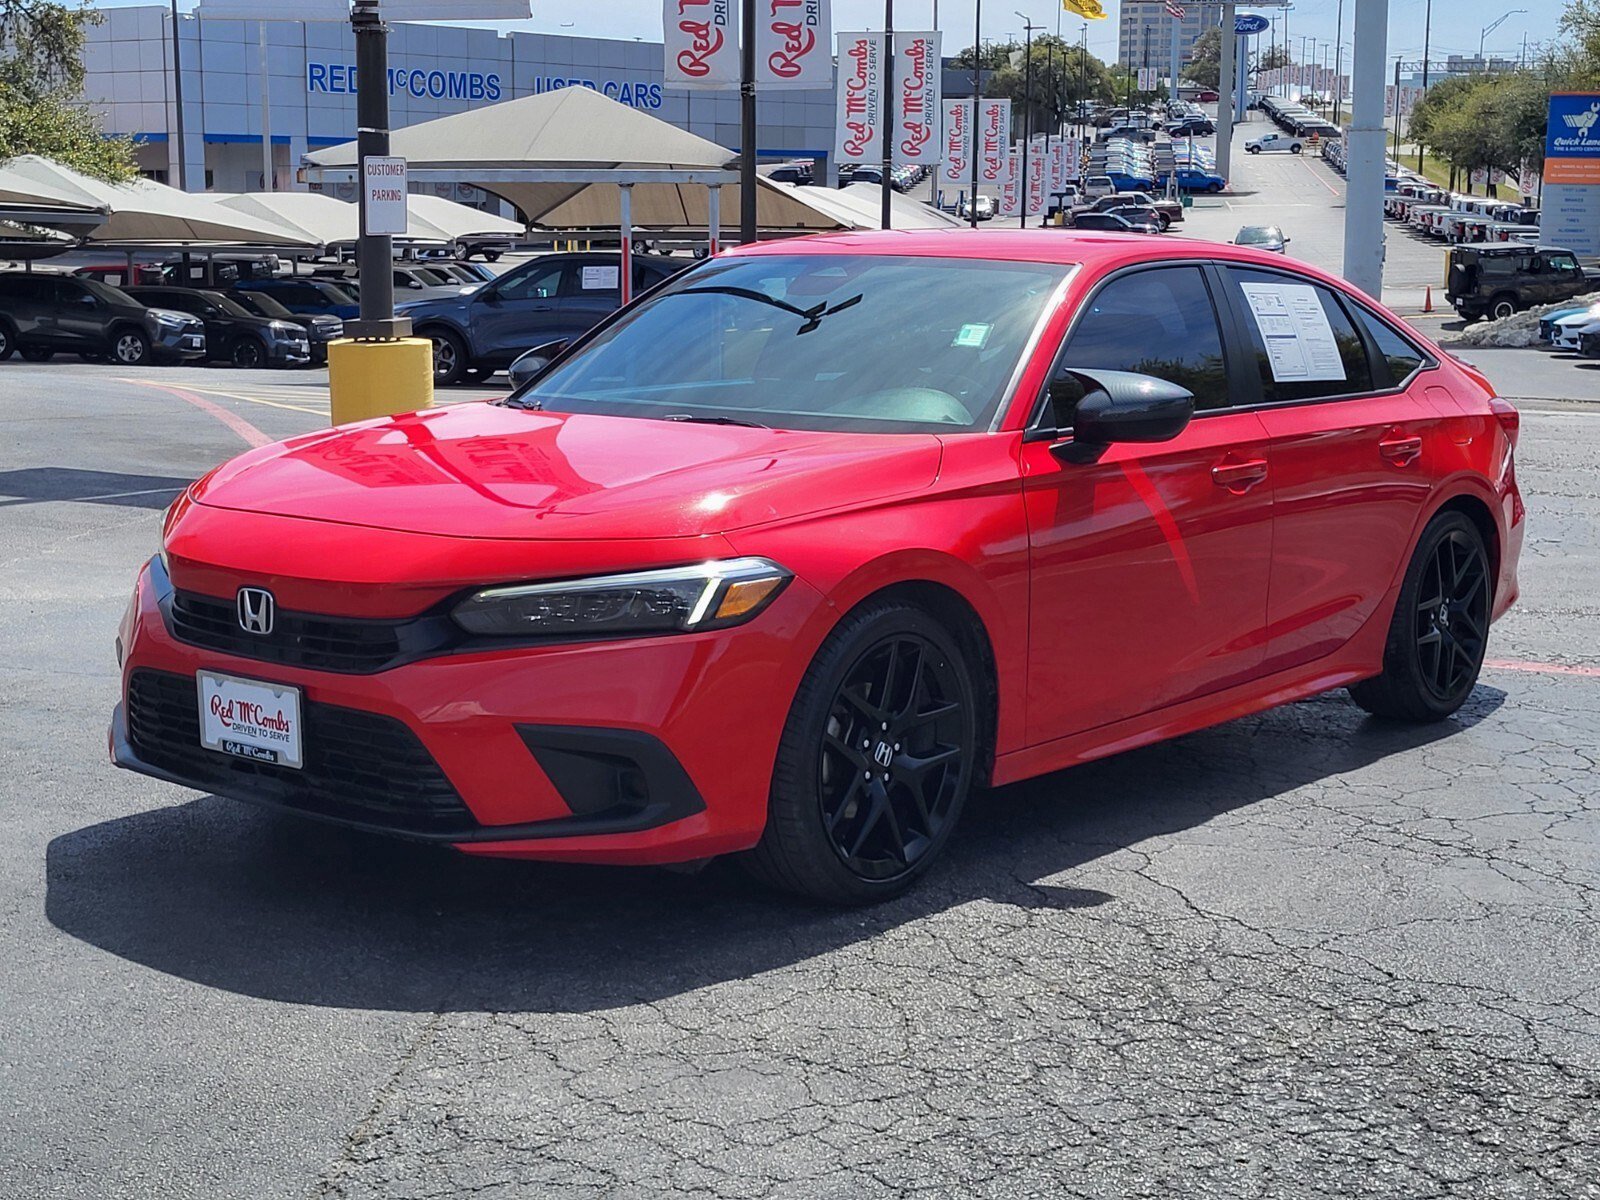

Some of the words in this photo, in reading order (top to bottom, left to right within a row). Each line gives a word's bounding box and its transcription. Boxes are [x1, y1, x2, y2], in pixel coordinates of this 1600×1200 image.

[677, 20, 724, 77] Red
[768, 21, 816, 78] Red
[868, 39, 876, 70] SERVE
[925, 39, 934, 70] SERVE
[603, 81, 662, 108] CARS
[846, 39, 868, 119] McCombs
[868, 72, 876, 86] TO
[903, 39, 925, 119] McCombs
[925, 72, 933, 86] TO
[868, 89, 876, 126] DRIVEN
[925, 89, 933, 126] DRIVEN
[843, 121, 873, 157] Red
[900, 121, 931, 157] Red
[948, 104, 963, 155] McCombs
[984, 104, 999, 155] McCombs
[1553, 137, 1581, 146] Quick
[367, 164, 405, 176] CUSTOMER
[947, 156, 966, 179] Red
[983, 157, 1003, 180] Red
[371, 189, 402, 202] PARKING
[210, 694, 235, 727] Red
[235, 699, 290, 733] McCombs
[232, 722, 258, 735] DRIVEN
[258, 728, 268, 738] TO
[269, 730, 290, 743] SERVE
